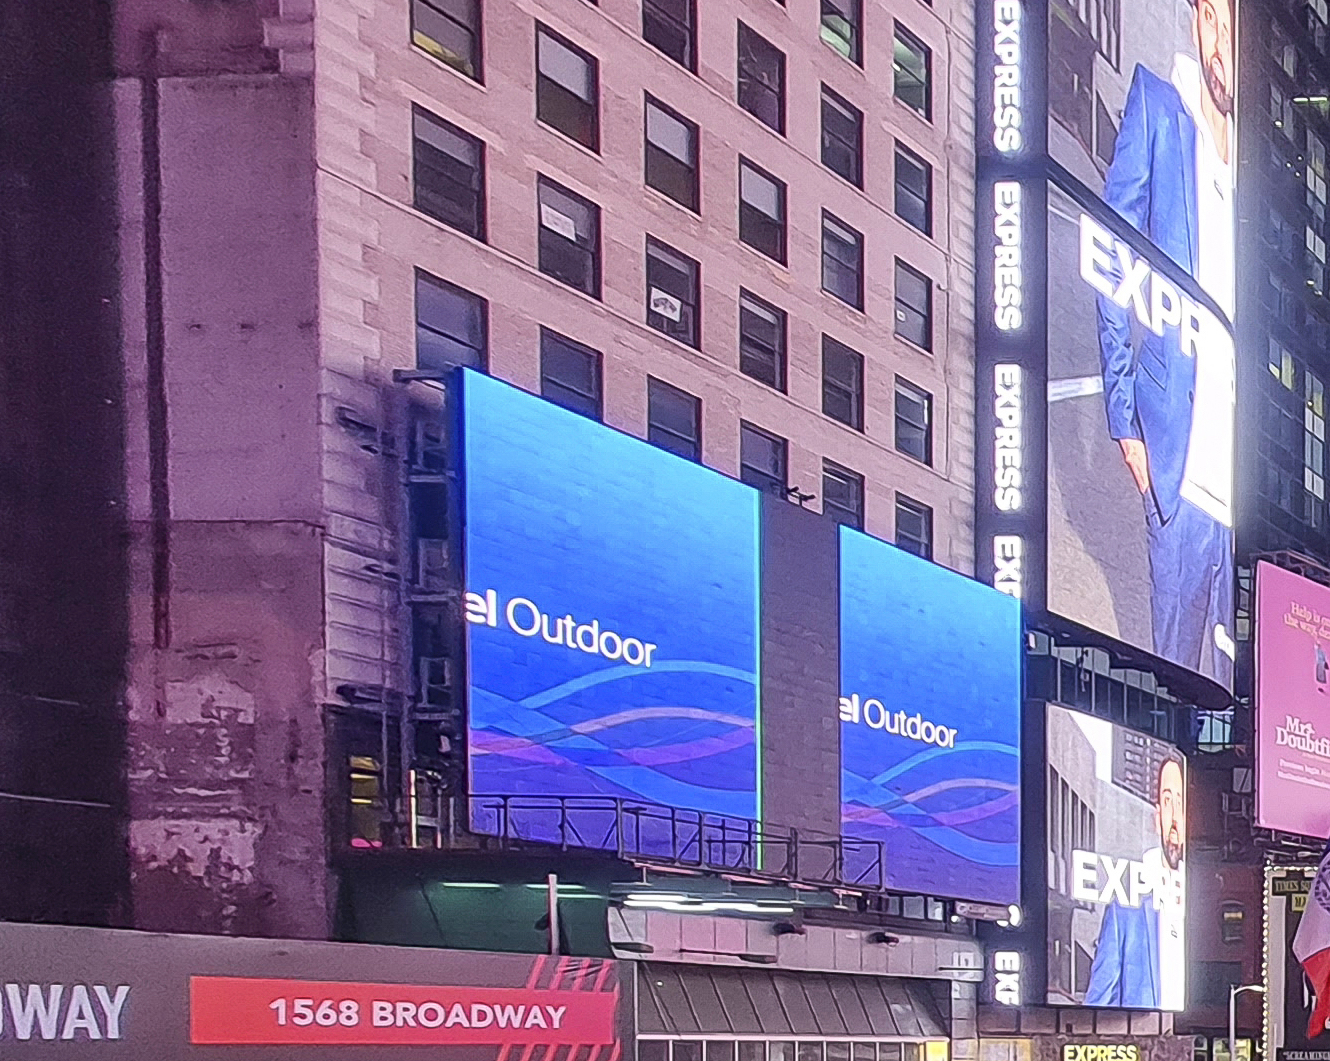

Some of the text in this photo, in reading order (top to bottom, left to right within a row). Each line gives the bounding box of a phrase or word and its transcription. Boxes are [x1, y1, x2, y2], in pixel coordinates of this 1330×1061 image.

[994, 1, 1022, 153] EXPRESS
[994, 181, 1022, 332] EXPRESS
[994, 363, 1022, 512] EXPRESS
[506, 597, 658, 668] Outdoor
[1283, 612, 1299, 628] the
[1290, 601, 1312, 624] Help
[863, 698, 959, 748] Outdoor
[0, 983, 131, 1040] WAY
[268, 997, 567, 1030] 1568 BROADWAY
